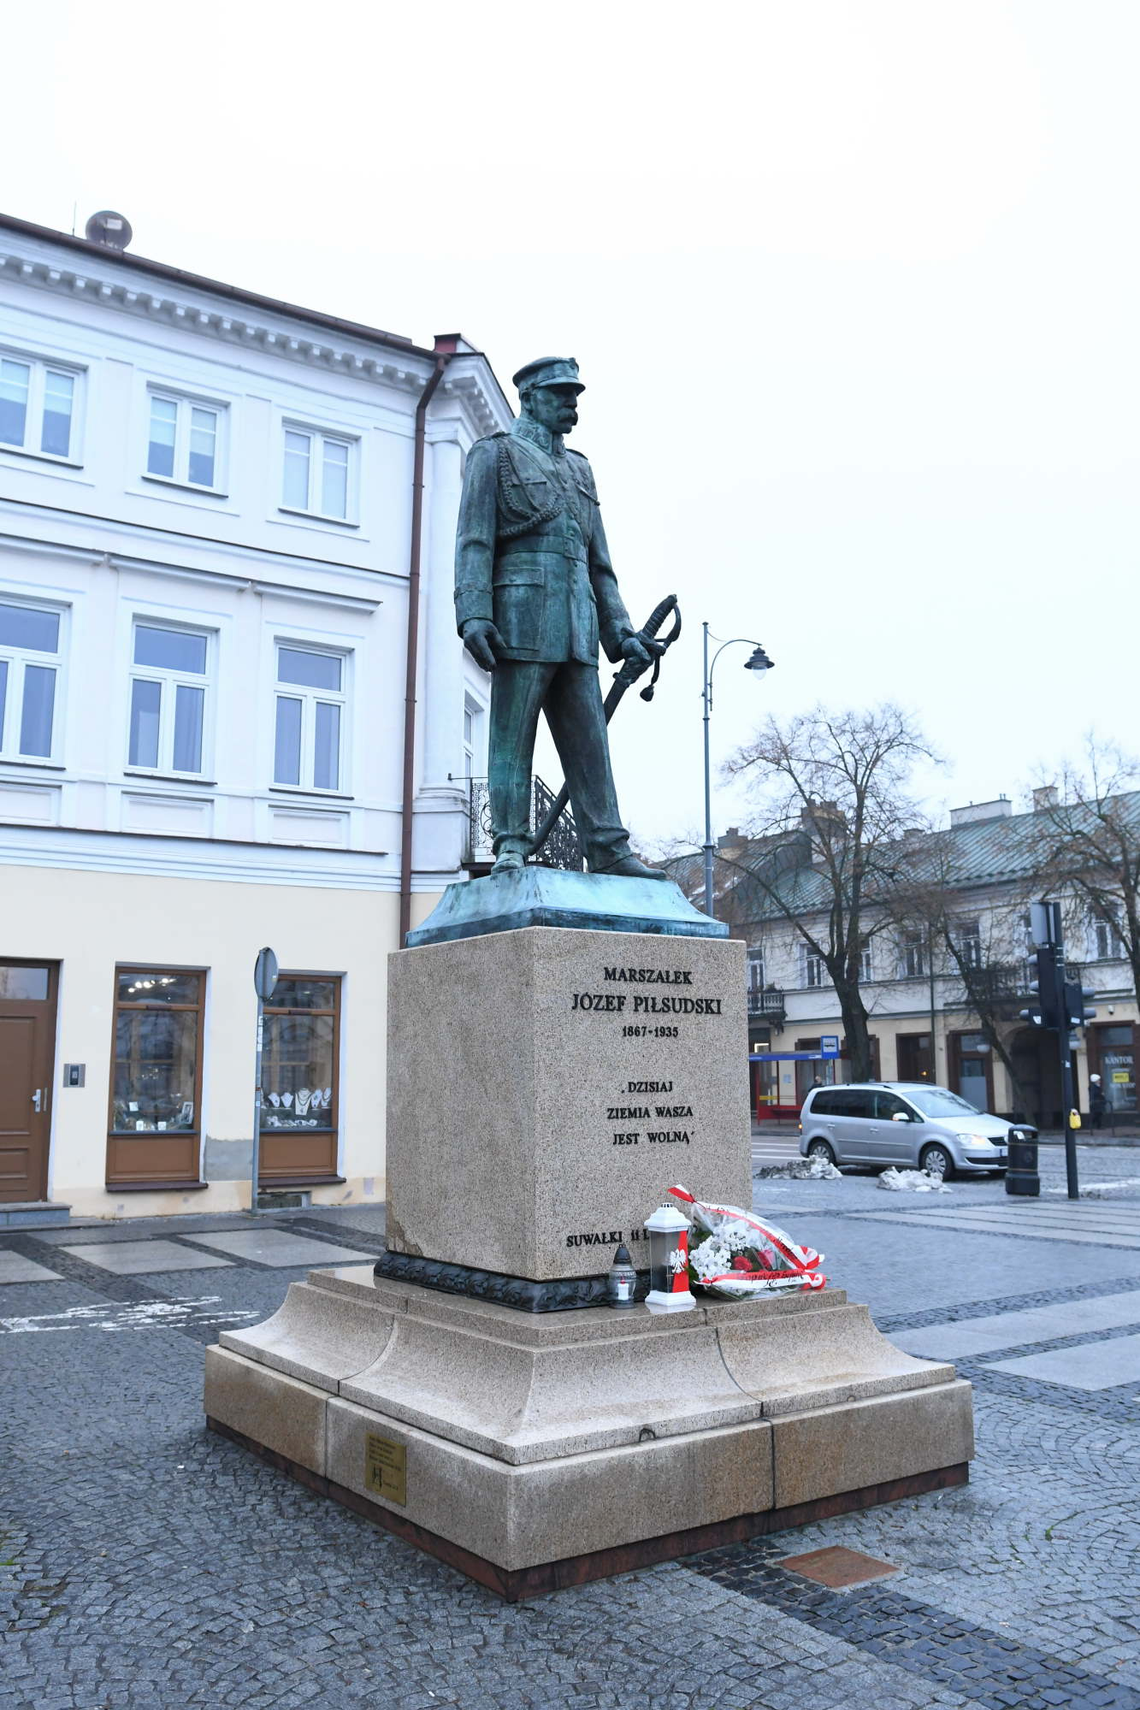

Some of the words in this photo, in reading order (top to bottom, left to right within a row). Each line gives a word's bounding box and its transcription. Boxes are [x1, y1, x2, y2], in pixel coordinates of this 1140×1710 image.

[603, 967, 693, 985] MARSZAŁEK
[571, 992, 626, 1012] JÓZEF
[633, 995, 722, 1014] PIŁSUDSKI
[622, 1025, 679, 1038] 1867-1935
[607, 1107, 651, 1120] ZIEMIA
[655, 1106, 694, 1118] WASZA
[613, 1133, 640, 1146] JEST
[566, 1231, 623, 1248] SUWAŁKI
